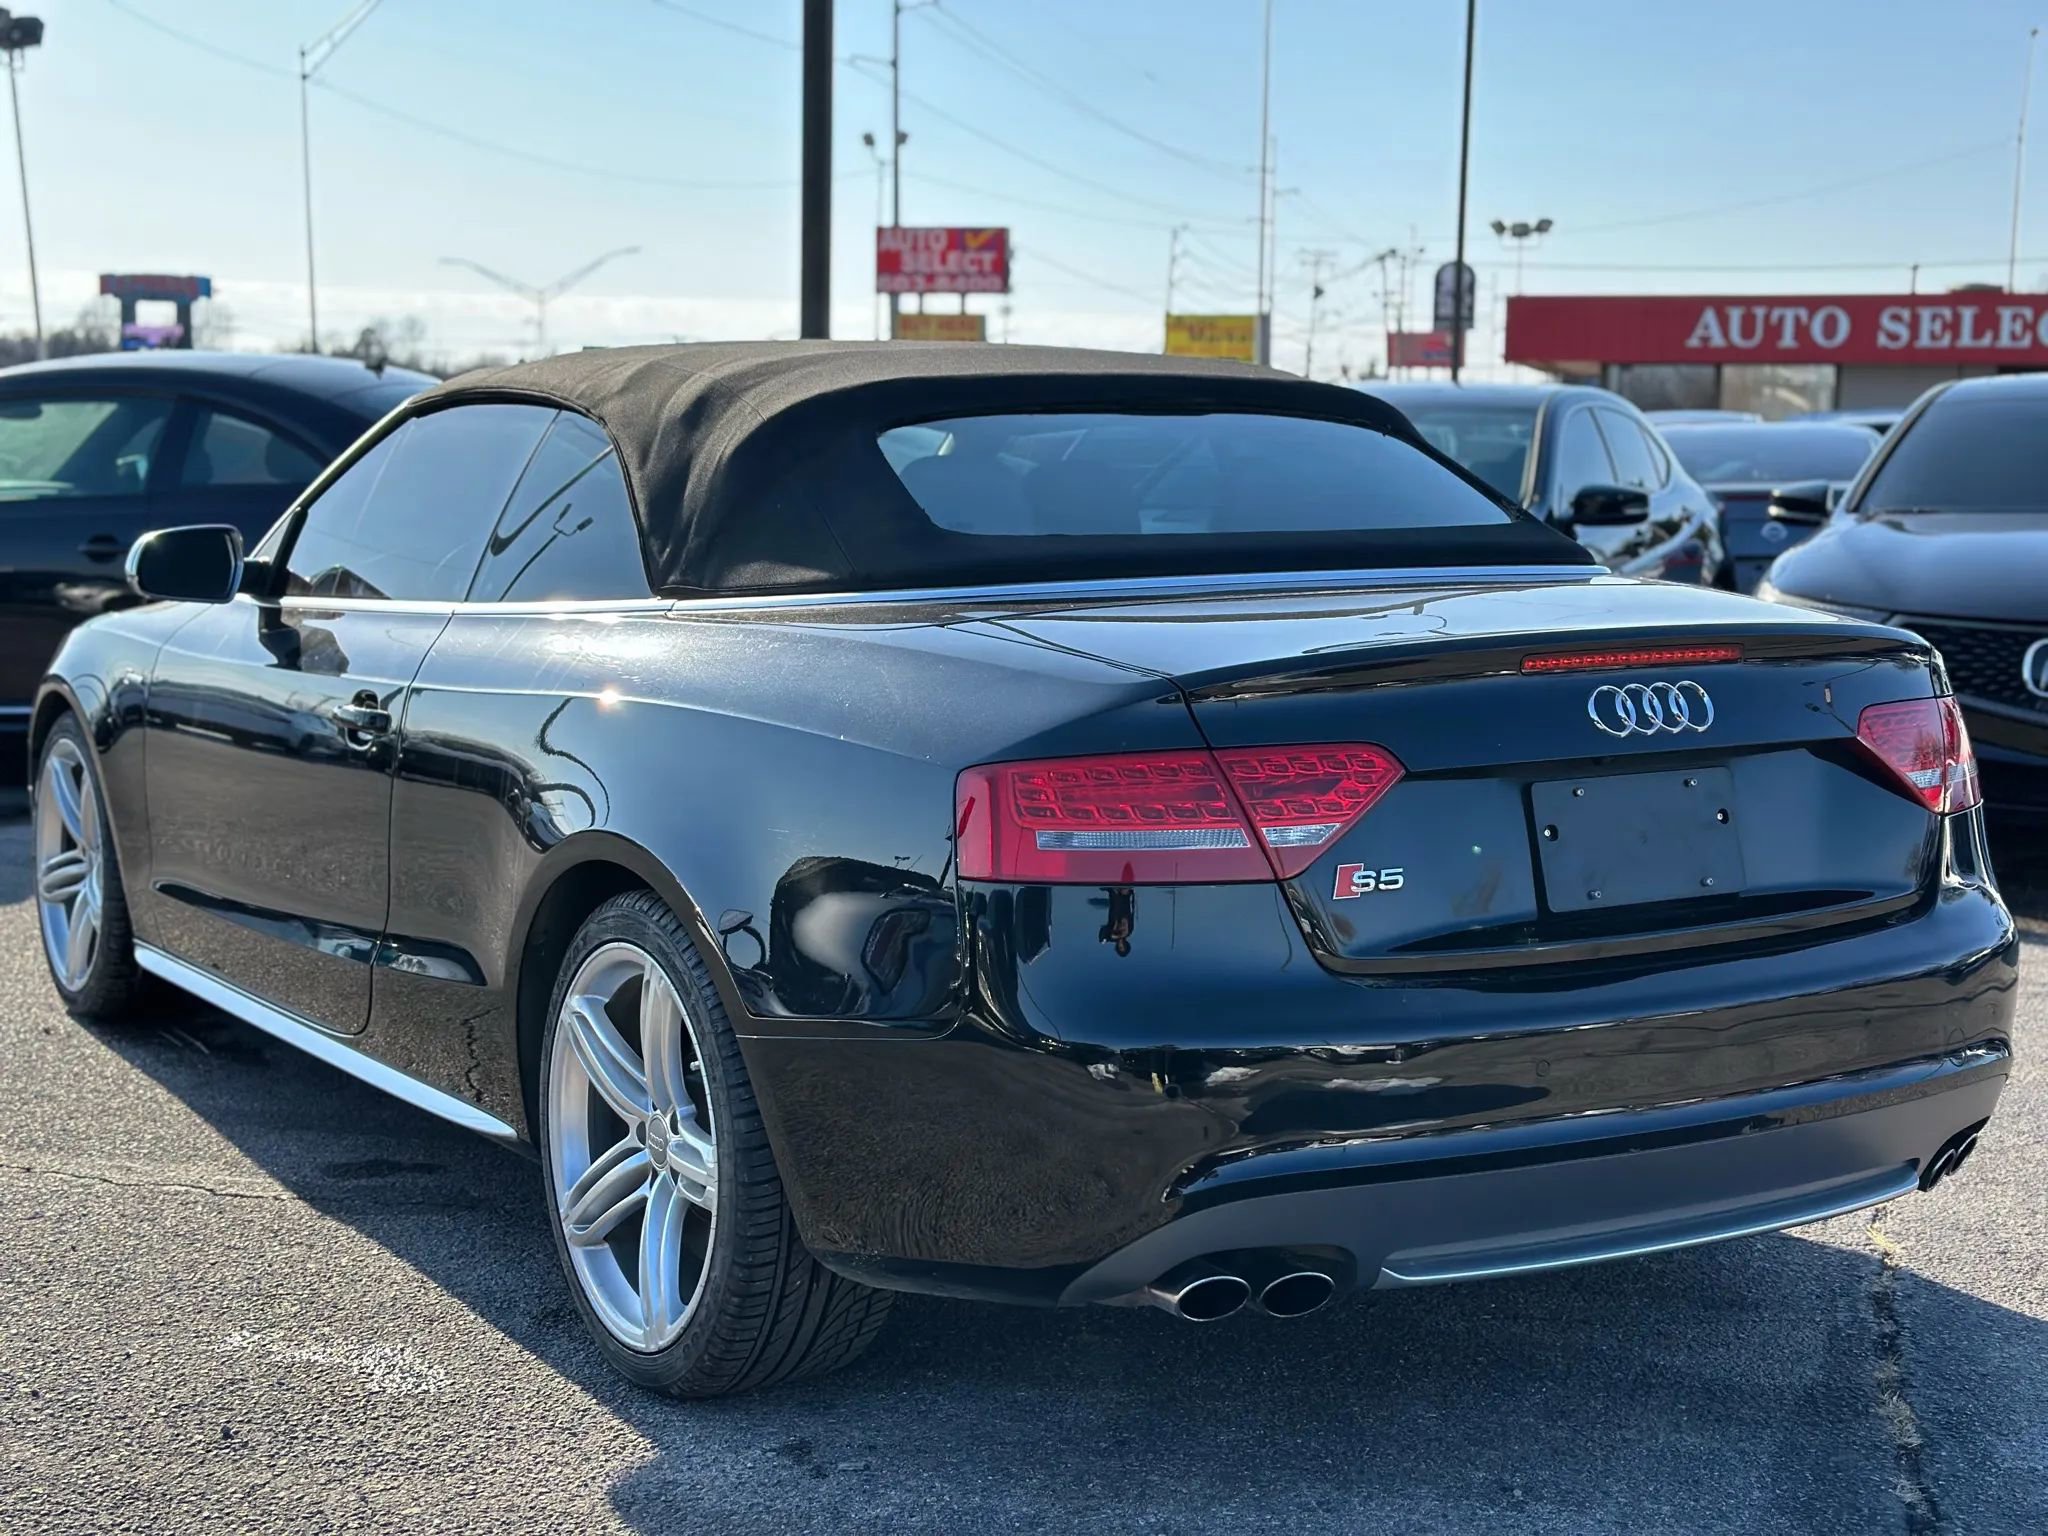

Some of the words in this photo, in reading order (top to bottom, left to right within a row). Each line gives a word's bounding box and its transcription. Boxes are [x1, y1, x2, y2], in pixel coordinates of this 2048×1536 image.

[879, 229, 948, 250] AUTO
[901, 251, 998, 273] SELECT
[1685, 305, 1851, 349] AUTO
[1350, 867, 1404, 893] S5
